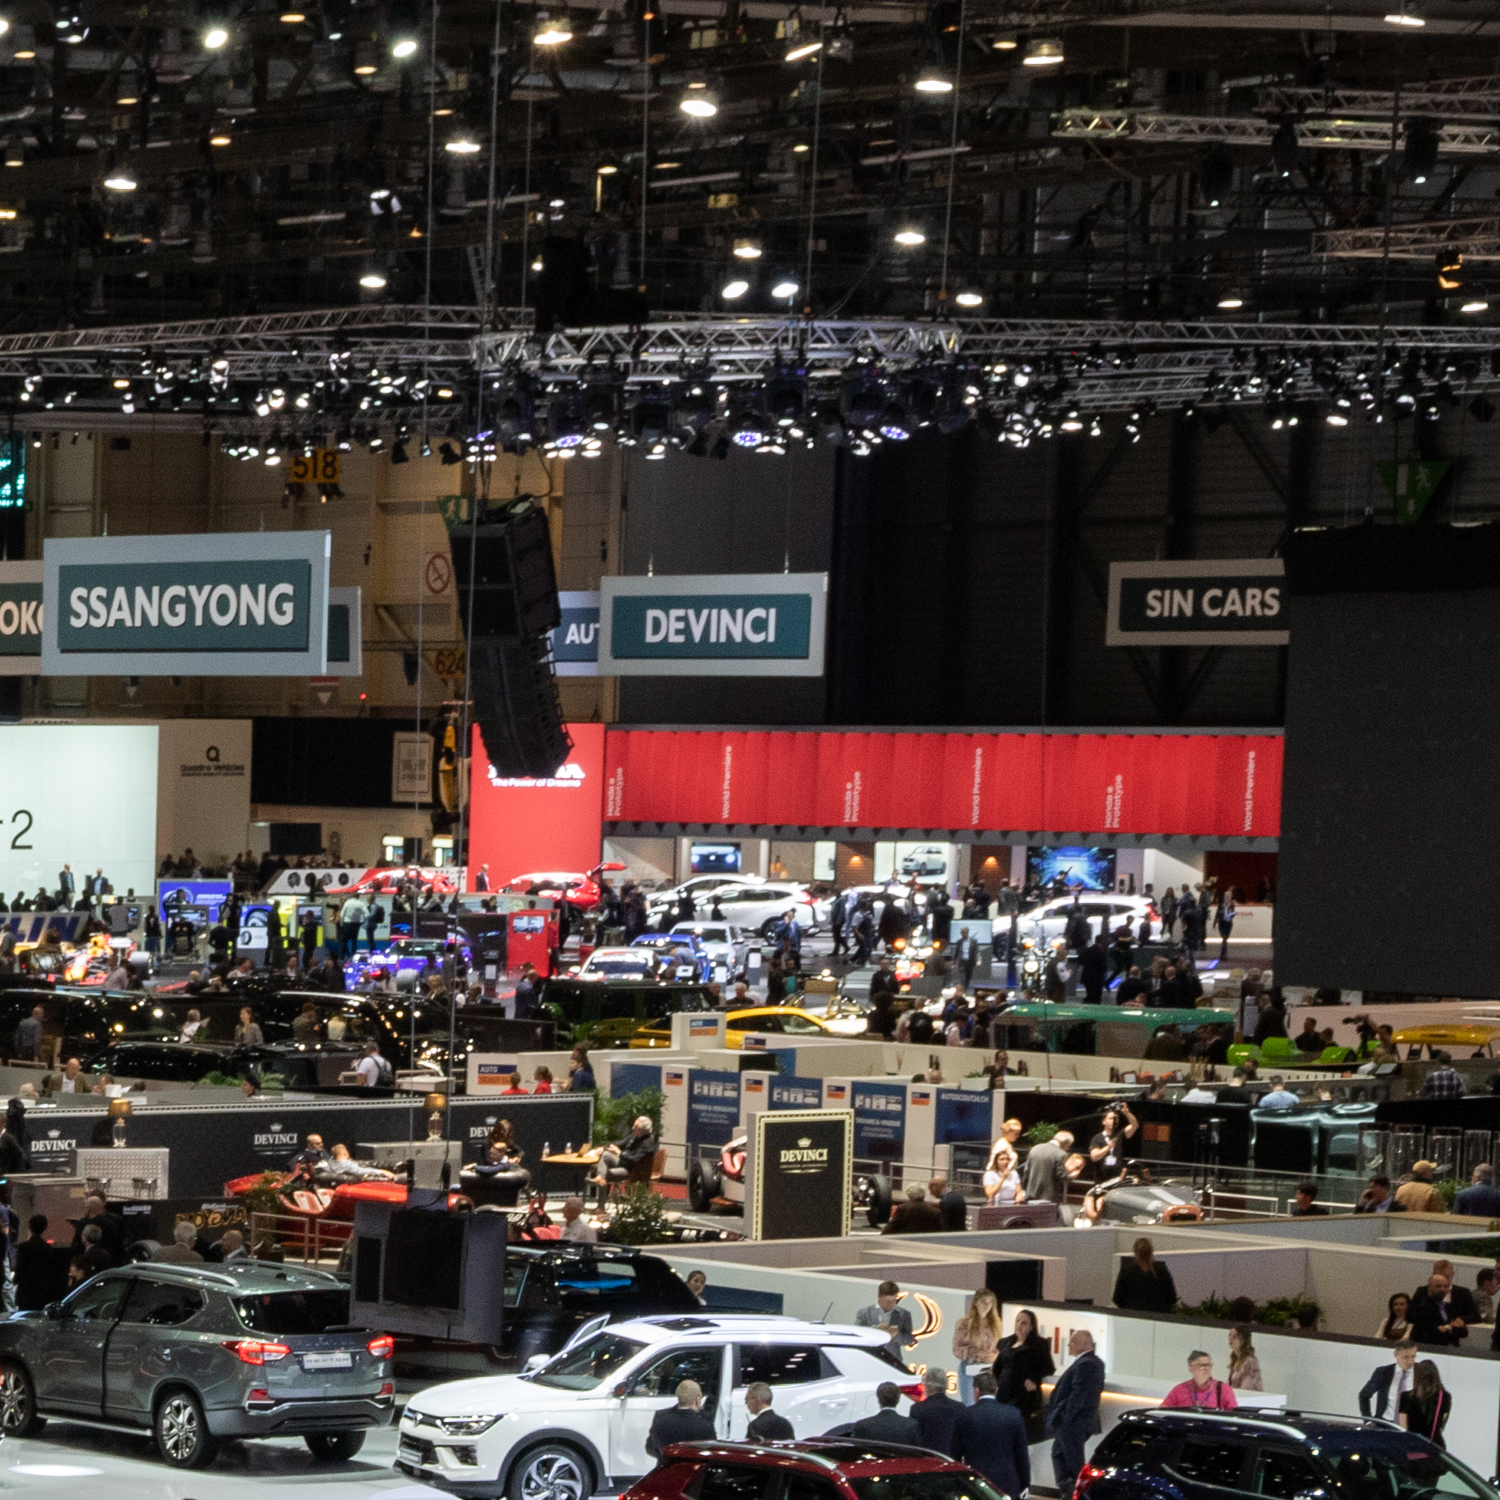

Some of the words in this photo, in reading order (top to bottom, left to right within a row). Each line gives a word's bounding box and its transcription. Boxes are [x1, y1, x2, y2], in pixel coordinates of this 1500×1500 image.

[293, 450, 338, 480] 518
[69, 582, 295, 628] SSANGYONG
[1145, 587, 1194, 618] SIN
[1201, 586, 1281, 618] CARS
[644, 607, 777, 645] DEVINCI
[435, 650, 467, 675] 624
[490, 778, 508, 788] The
[509, 778, 536, 788] Power
[536, 778, 547, 788] of
[547, 778, 582, 788] Dreams
[10, 809, 34, 850] 2
[30, 1139, 77, 1152] DEVINCI
[253, 1133, 298, 1145] DEVINCI
[779, 1148, 829, 1163] DEVINCI
